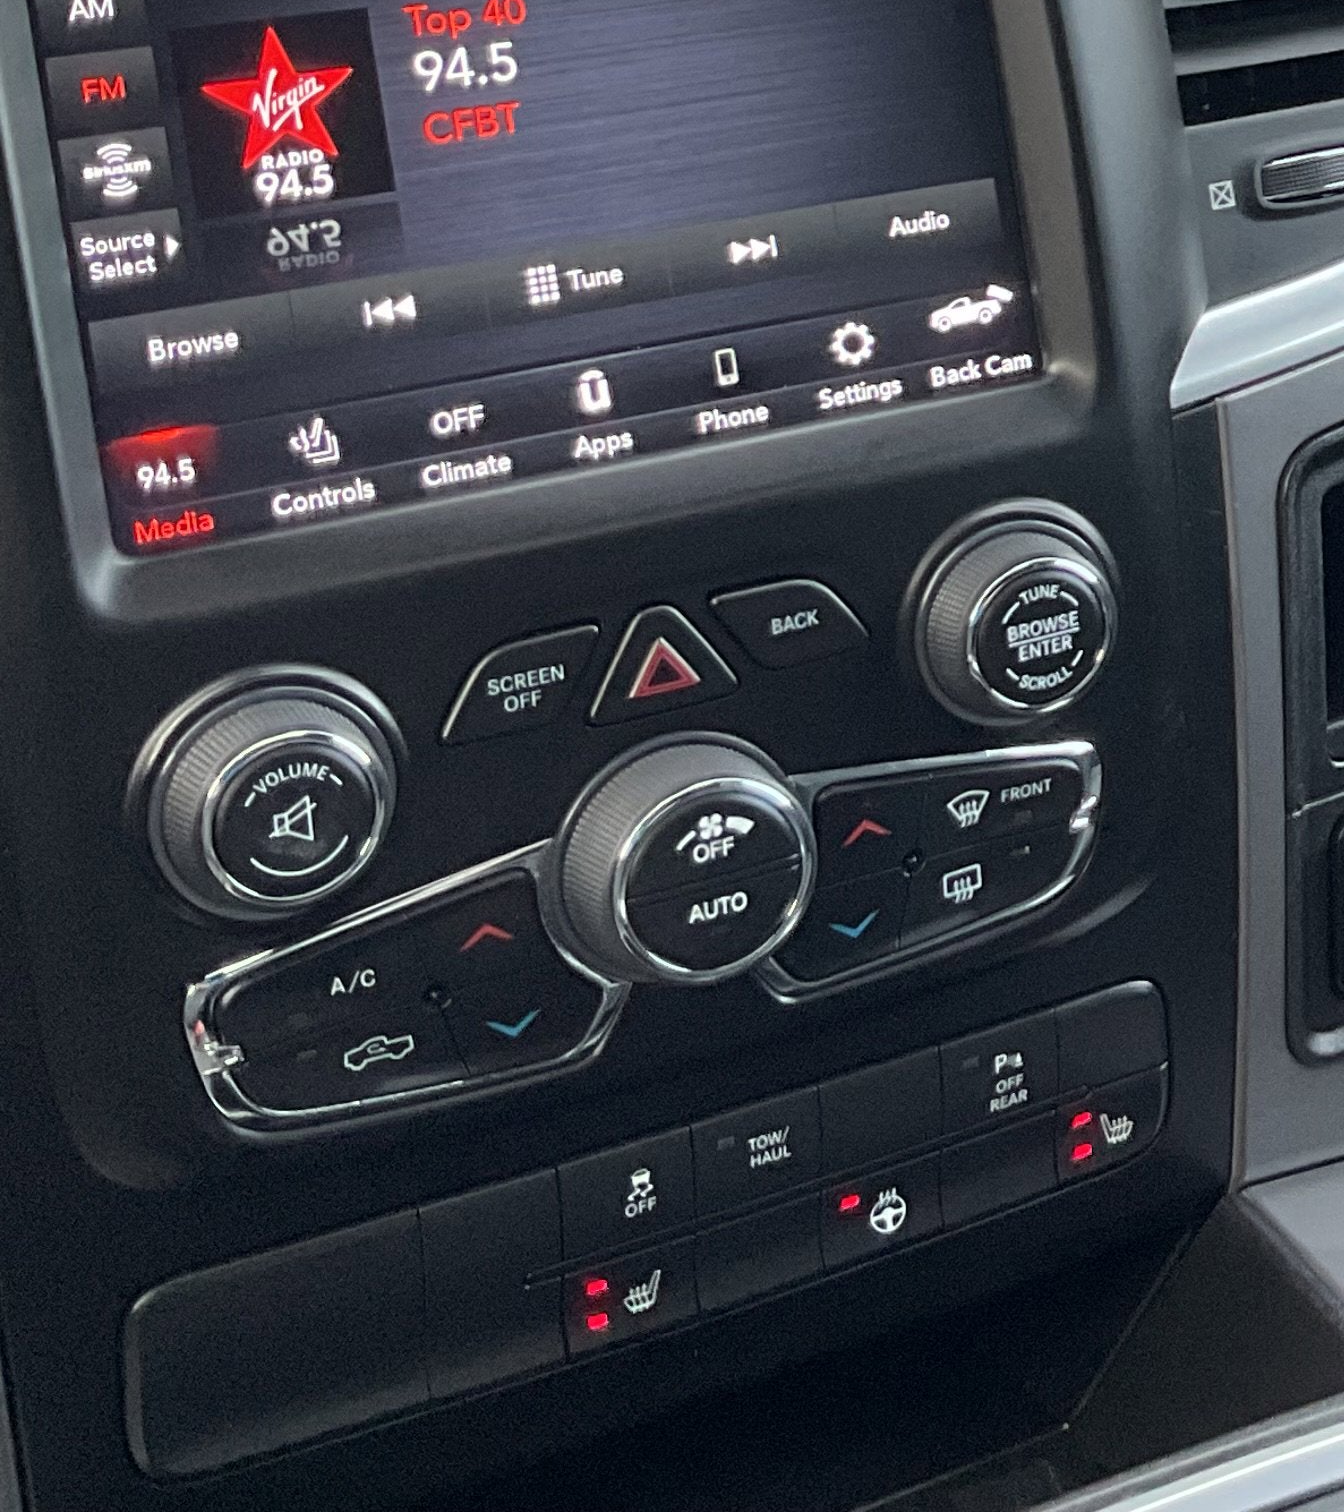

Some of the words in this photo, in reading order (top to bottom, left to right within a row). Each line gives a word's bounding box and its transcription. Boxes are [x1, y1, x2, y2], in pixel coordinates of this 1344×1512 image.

[401, 2, 473, 40] Top
[412, 41, 519, 94] 94.5
[81, 73, 127, 103] FM
[252, 68, 325, 132] Virgin
[422, 99, 522, 146] CFBT
[261, 148, 325, 170] RADIO
[256, 164, 335, 203] 94.5
[79, 232, 156, 257] Source
[89, 255, 158, 281] Select
[148, 330, 240, 362] Browse
[566, 266, 625, 291] Tune
[888, 210, 951, 239] Audio
[132, 510, 215, 545] Media
[271, 477, 376, 516] Controls
[421, 453, 513, 487] Climate
[572, 431, 634, 460] Apps
[698, 404, 769, 434] Phone
[817, 377, 904, 410] Settings
[929, 359, 982, 388] Back
[984, 351, 1033, 377] Cam
[136, 457, 197, 491] 94.5
[431, 403, 486, 436] OFF
[1019, 584, 1061, 606] TUNE
[770, 609, 820, 635] BACK
[1006, 610, 1080, 643] BROWSE
[1018, 634, 1074, 663] ENTER
[487, 664, 566, 696] SCREEN
[1018, 666, 1074, 691] SCROLL
[503, 690, 543, 714] OFF
[253, 762, 330, 794] VOLUME
[1000, 777, 1053, 804] FRONT
[692, 836, 736, 864] OFF
[688, 891, 750, 925] AUTO
[329, 968, 377, 998] A/C
[995, 1073, 1025, 1094] OFF
[989, 1089, 1029, 1113] REAR
[750, 1145, 792, 1169] HAUL
[624, 1195, 658, 1219] OFF
